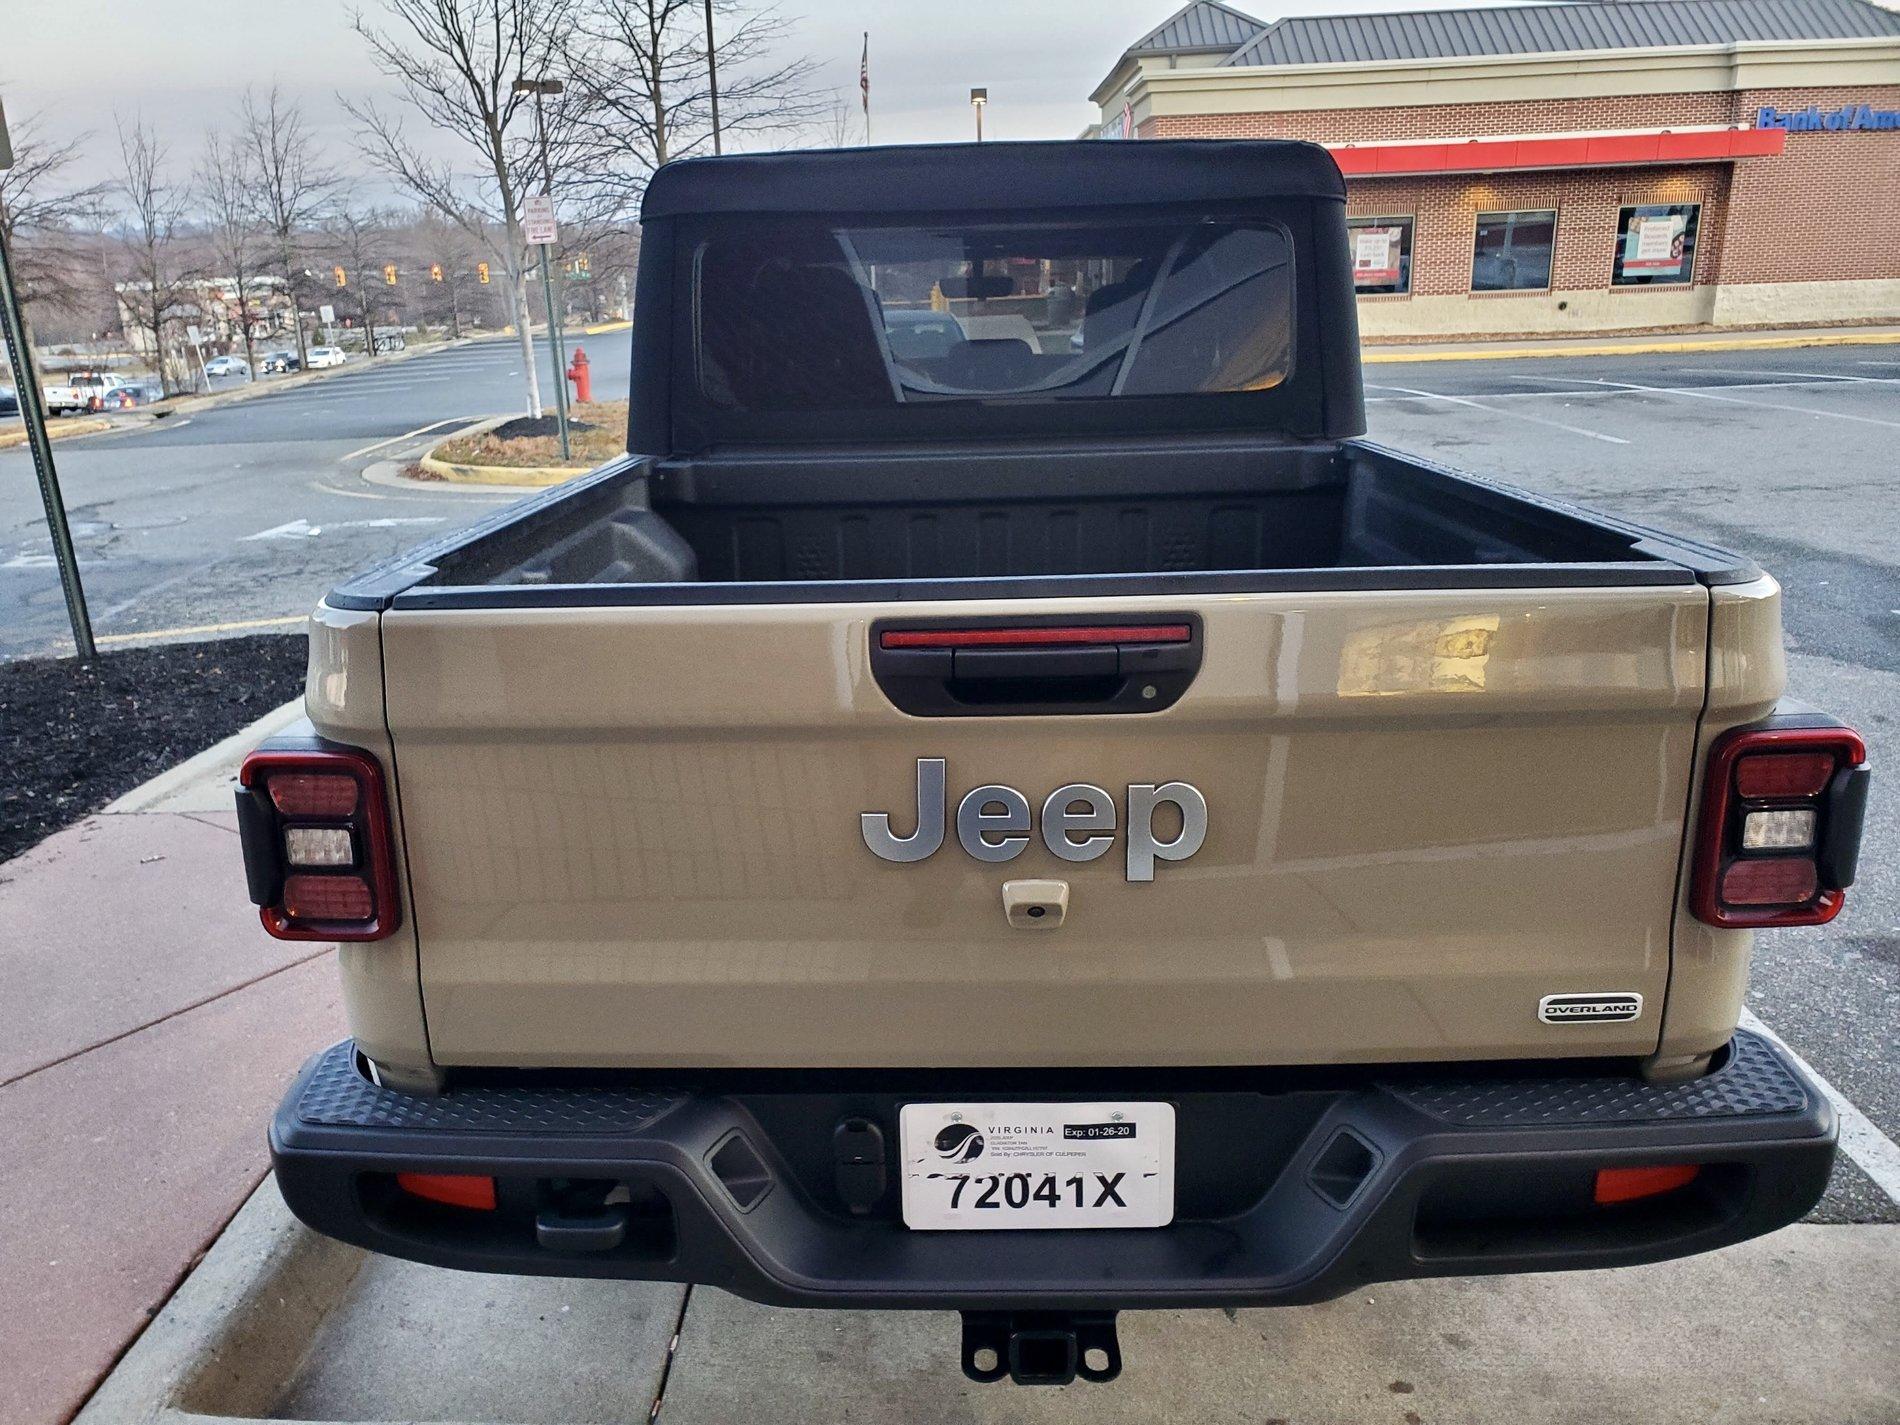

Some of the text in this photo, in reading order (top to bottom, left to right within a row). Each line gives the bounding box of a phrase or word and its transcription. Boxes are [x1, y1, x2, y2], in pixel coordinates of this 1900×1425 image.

[1756, 105, 1823, 131] Bank
[1823, 104, 1853, 130] of
[860, 758, 1208, 882] Jeep
[1545, 1005, 1638, 1013] OVERLAND
[988, 1126, 1054, 1134] VIRGINIA
[1065, 1127, 1130, 1137] Exp: 01-26-20
[947, 1172, 1127, 1209] 72041X
